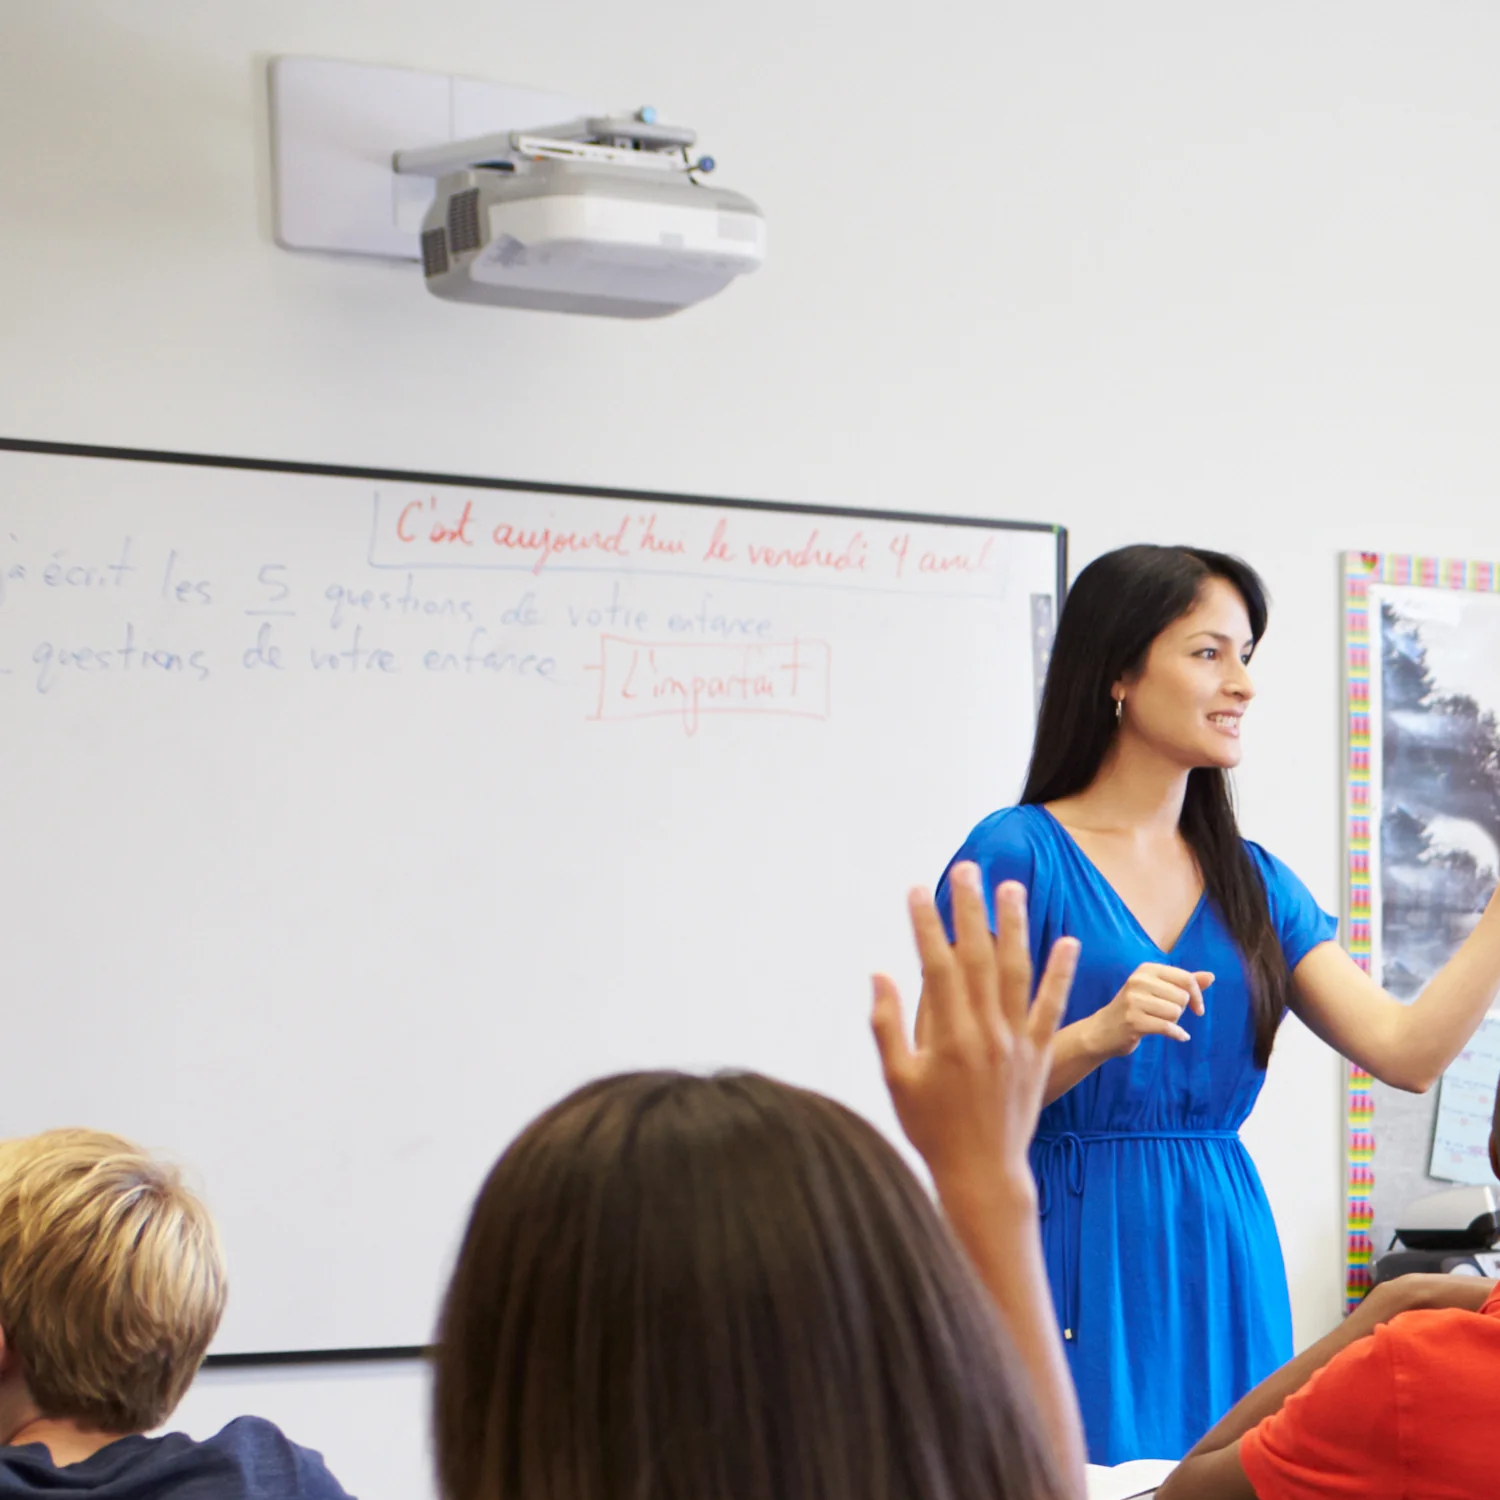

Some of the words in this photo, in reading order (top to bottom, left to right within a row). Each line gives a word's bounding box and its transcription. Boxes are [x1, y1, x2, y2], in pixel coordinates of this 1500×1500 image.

[396, 494, 478, 547] C'est
[493, 511, 686, 577] aujourd'hui
[703, 516, 737, 562] le
[747, 527, 870, 573] vendredi
[888, 532, 911, 578] 4
[160, 549, 214, 607] les
[256, 562, 292, 604] 5
[323, 572, 476, 631] questions
[501, 591, 545, 627] de
[566, 581, 651, 633] votre
[667, 591, 774, 638] enfance
[30, 621, 212, 695] questions
[241, 621, 288, 671] de
[309, 623, 403, 674] votre
[423, 626, 560, 677] enfance
